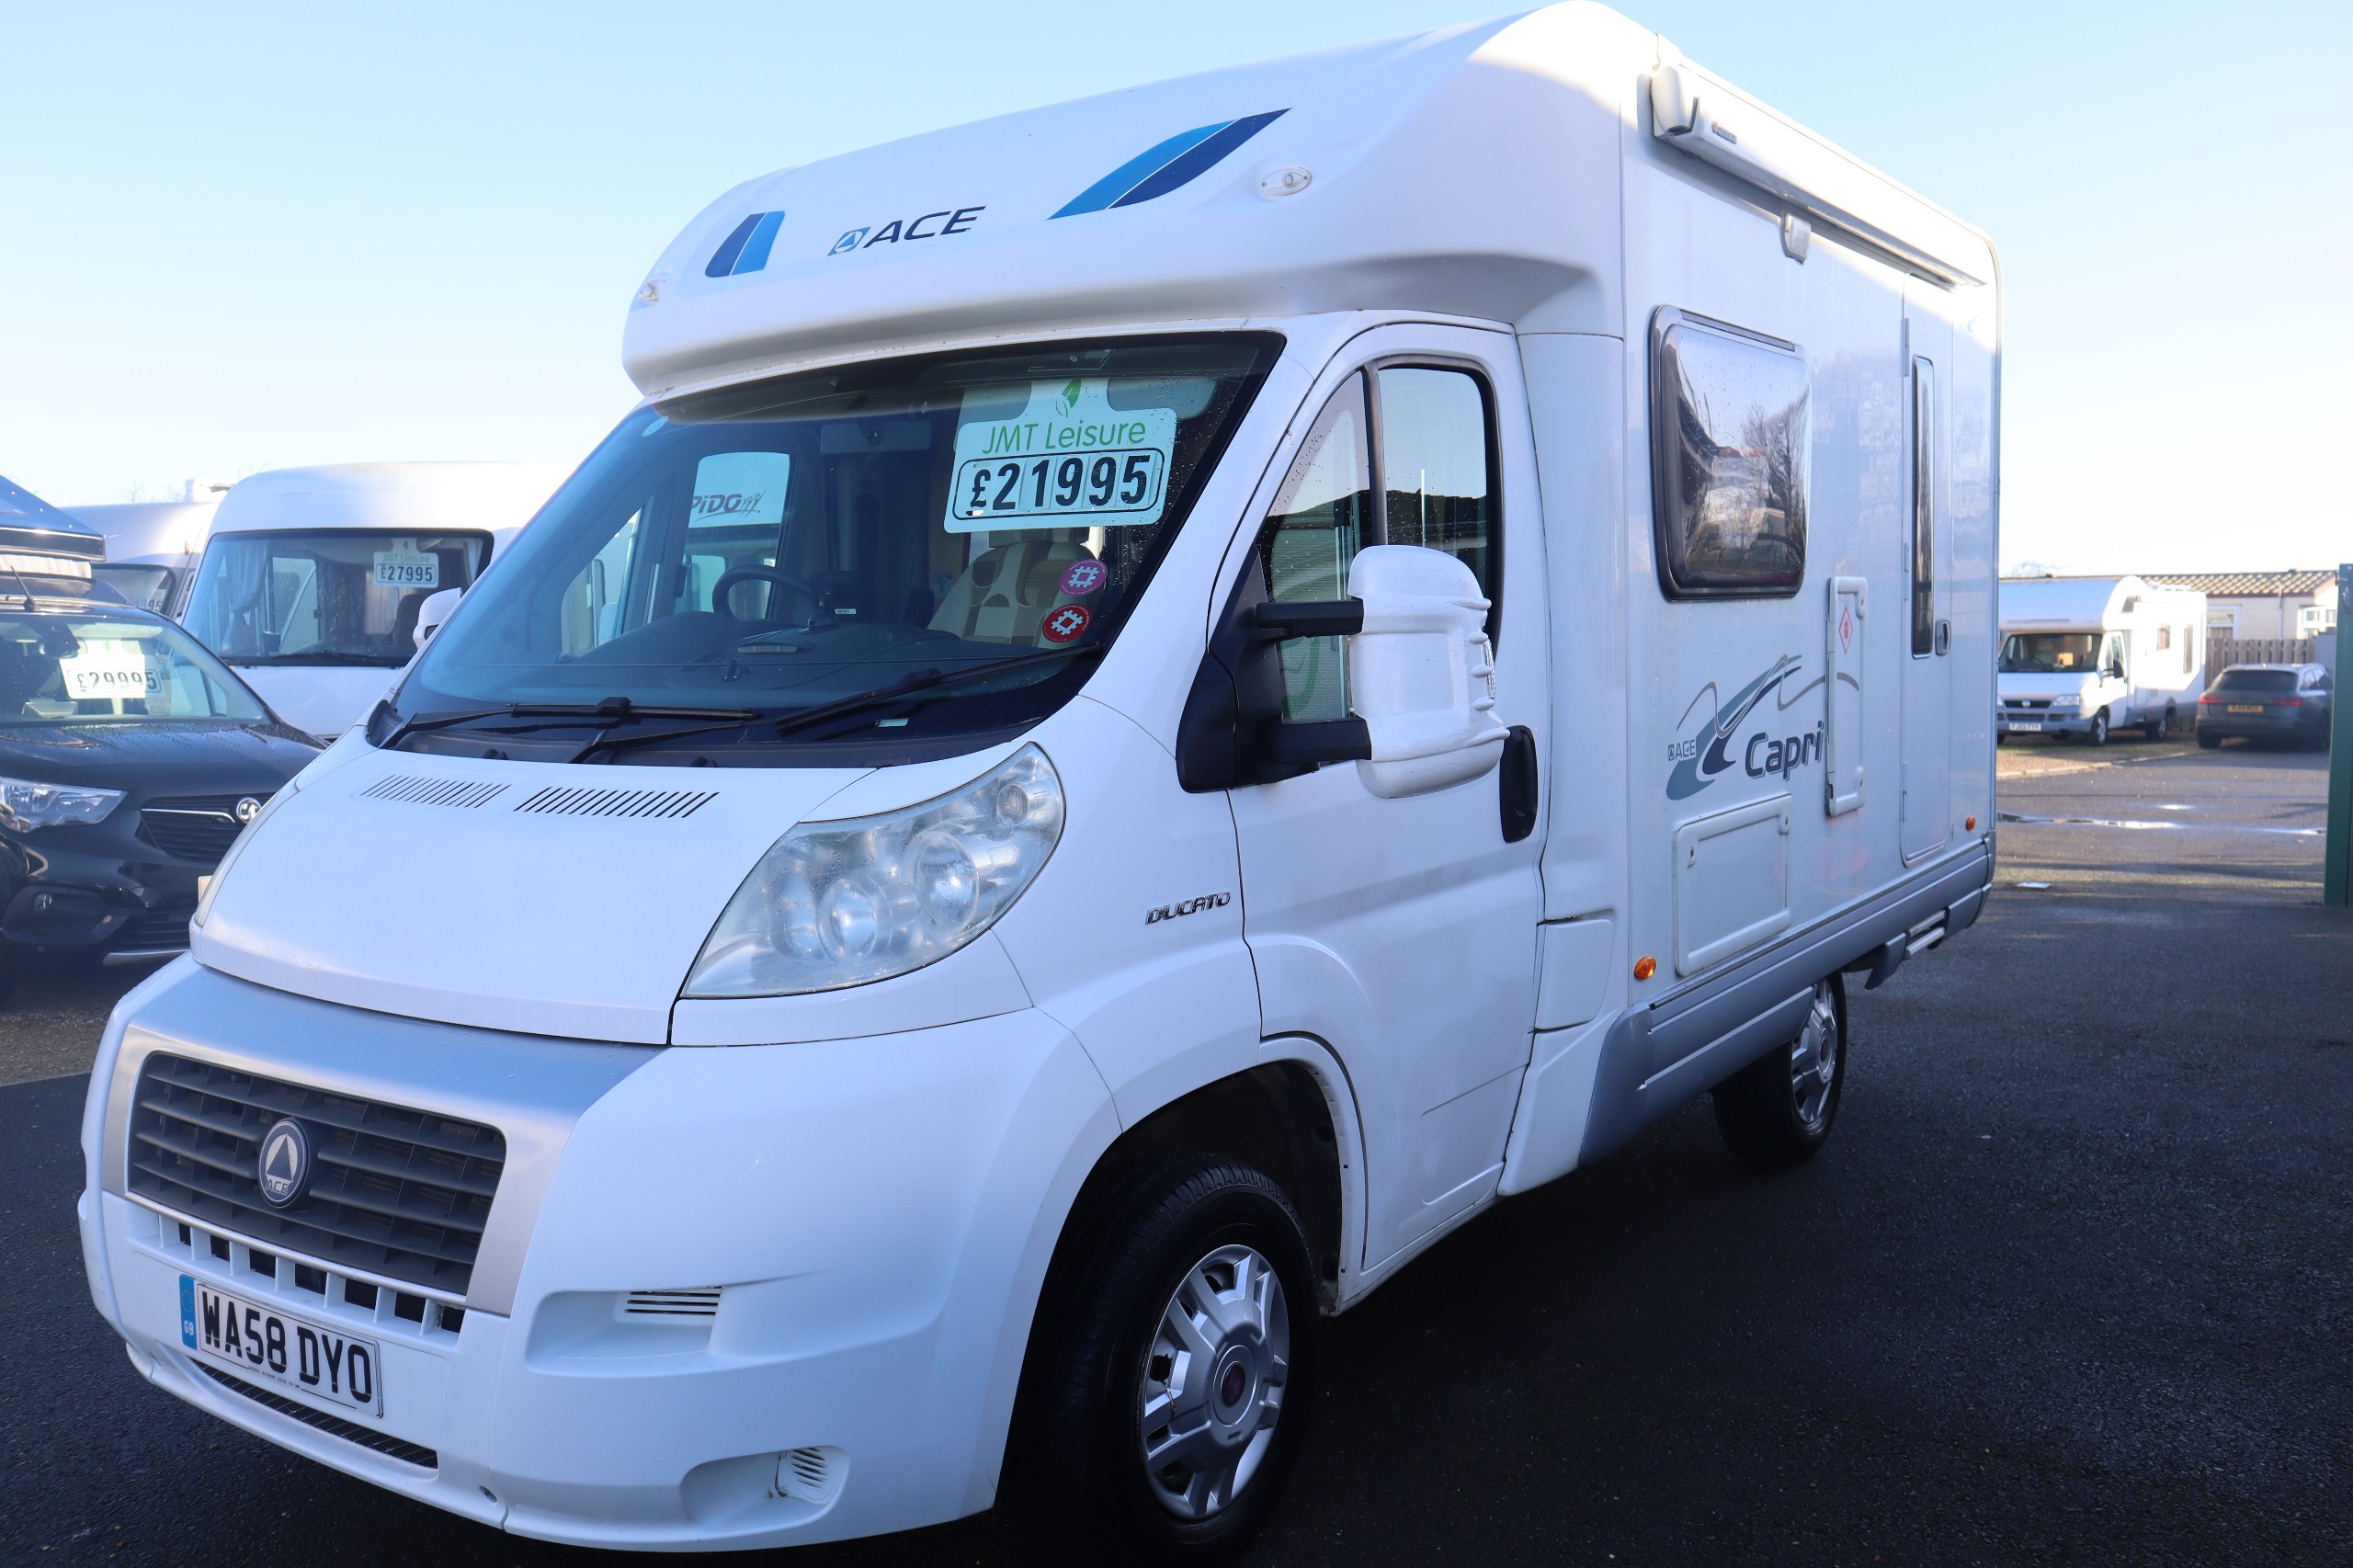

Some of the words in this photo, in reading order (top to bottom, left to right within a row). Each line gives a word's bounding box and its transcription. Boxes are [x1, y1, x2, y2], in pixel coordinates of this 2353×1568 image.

[861, 205, 987, 249] ACE
[982, 423, 1040, 455] JMT
[1044, 418, 1147, 450] Leisure
[970, 454, 1151, 511] £21995
[380, 564, 433, 583] £27995
[381, 553, 398, 563] JMT
[400, 553, 431, 564] Leisure
[76, 671, 158, 691] £29995
[1675, 738, 1697, 760] ACE
[1745, 720, 1824, 781] Capri
[1144, 890, 1232, 926] DUCATO
[265, 1178, 290, 1196] ACE
[184, 1320, 195, 1336] GB
[201, 1290, 288, 1374] WA58
[296, 1325, 372, 1403] DYO
